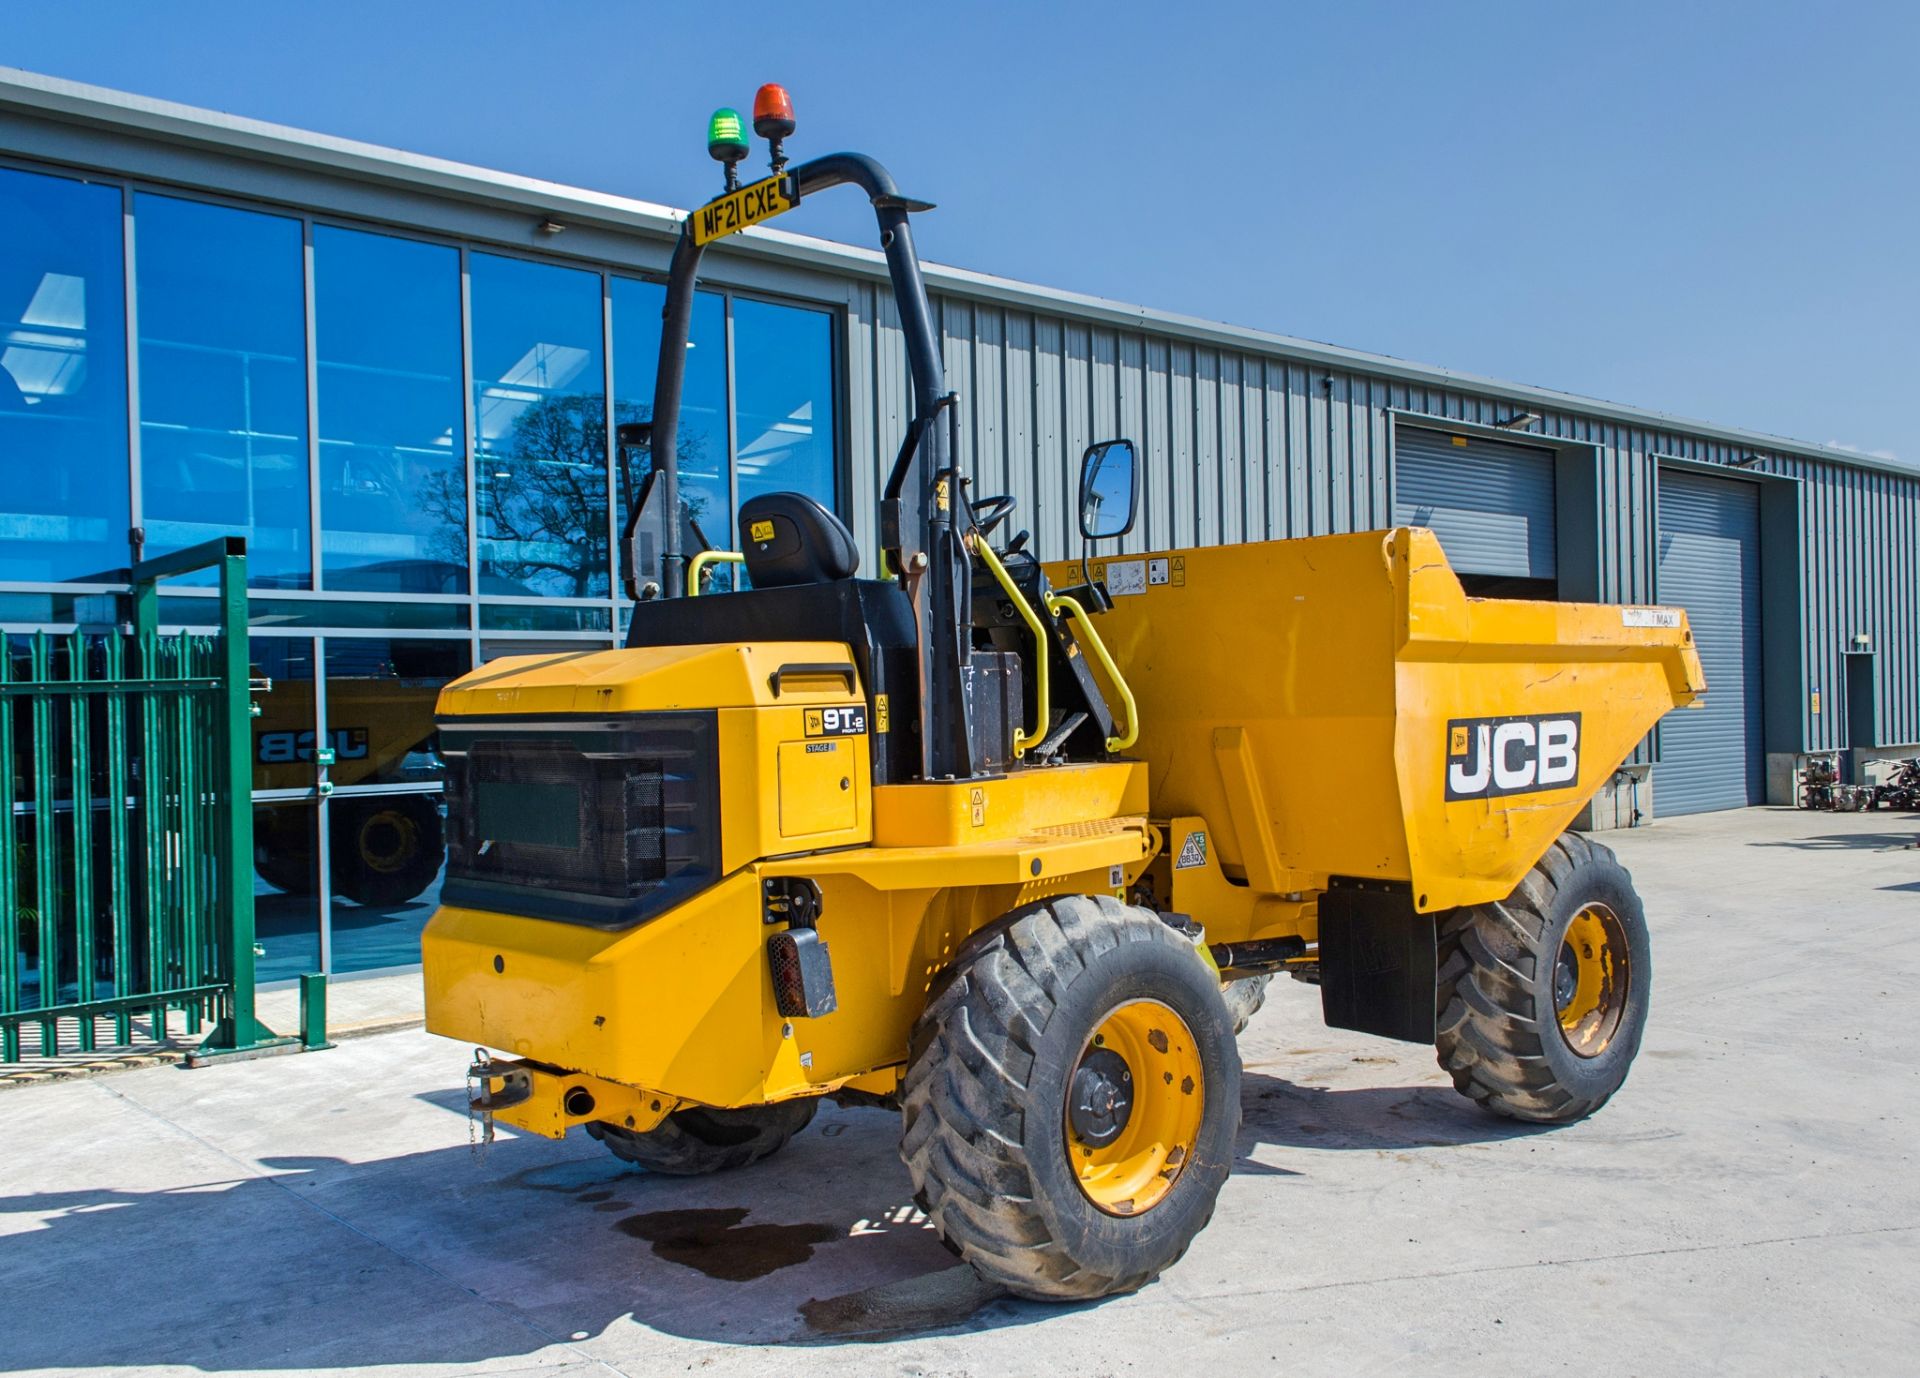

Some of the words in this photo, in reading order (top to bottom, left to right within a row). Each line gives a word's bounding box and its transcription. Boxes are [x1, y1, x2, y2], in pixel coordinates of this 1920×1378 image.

[703, 198, 741, 237] MF21
[744, 181, 778, 220] CXE
[1656, 614, 1673, 625] MAX
[806, 743, 828, 753] STAGE
[1450, 720, 1577, 794] JCB
